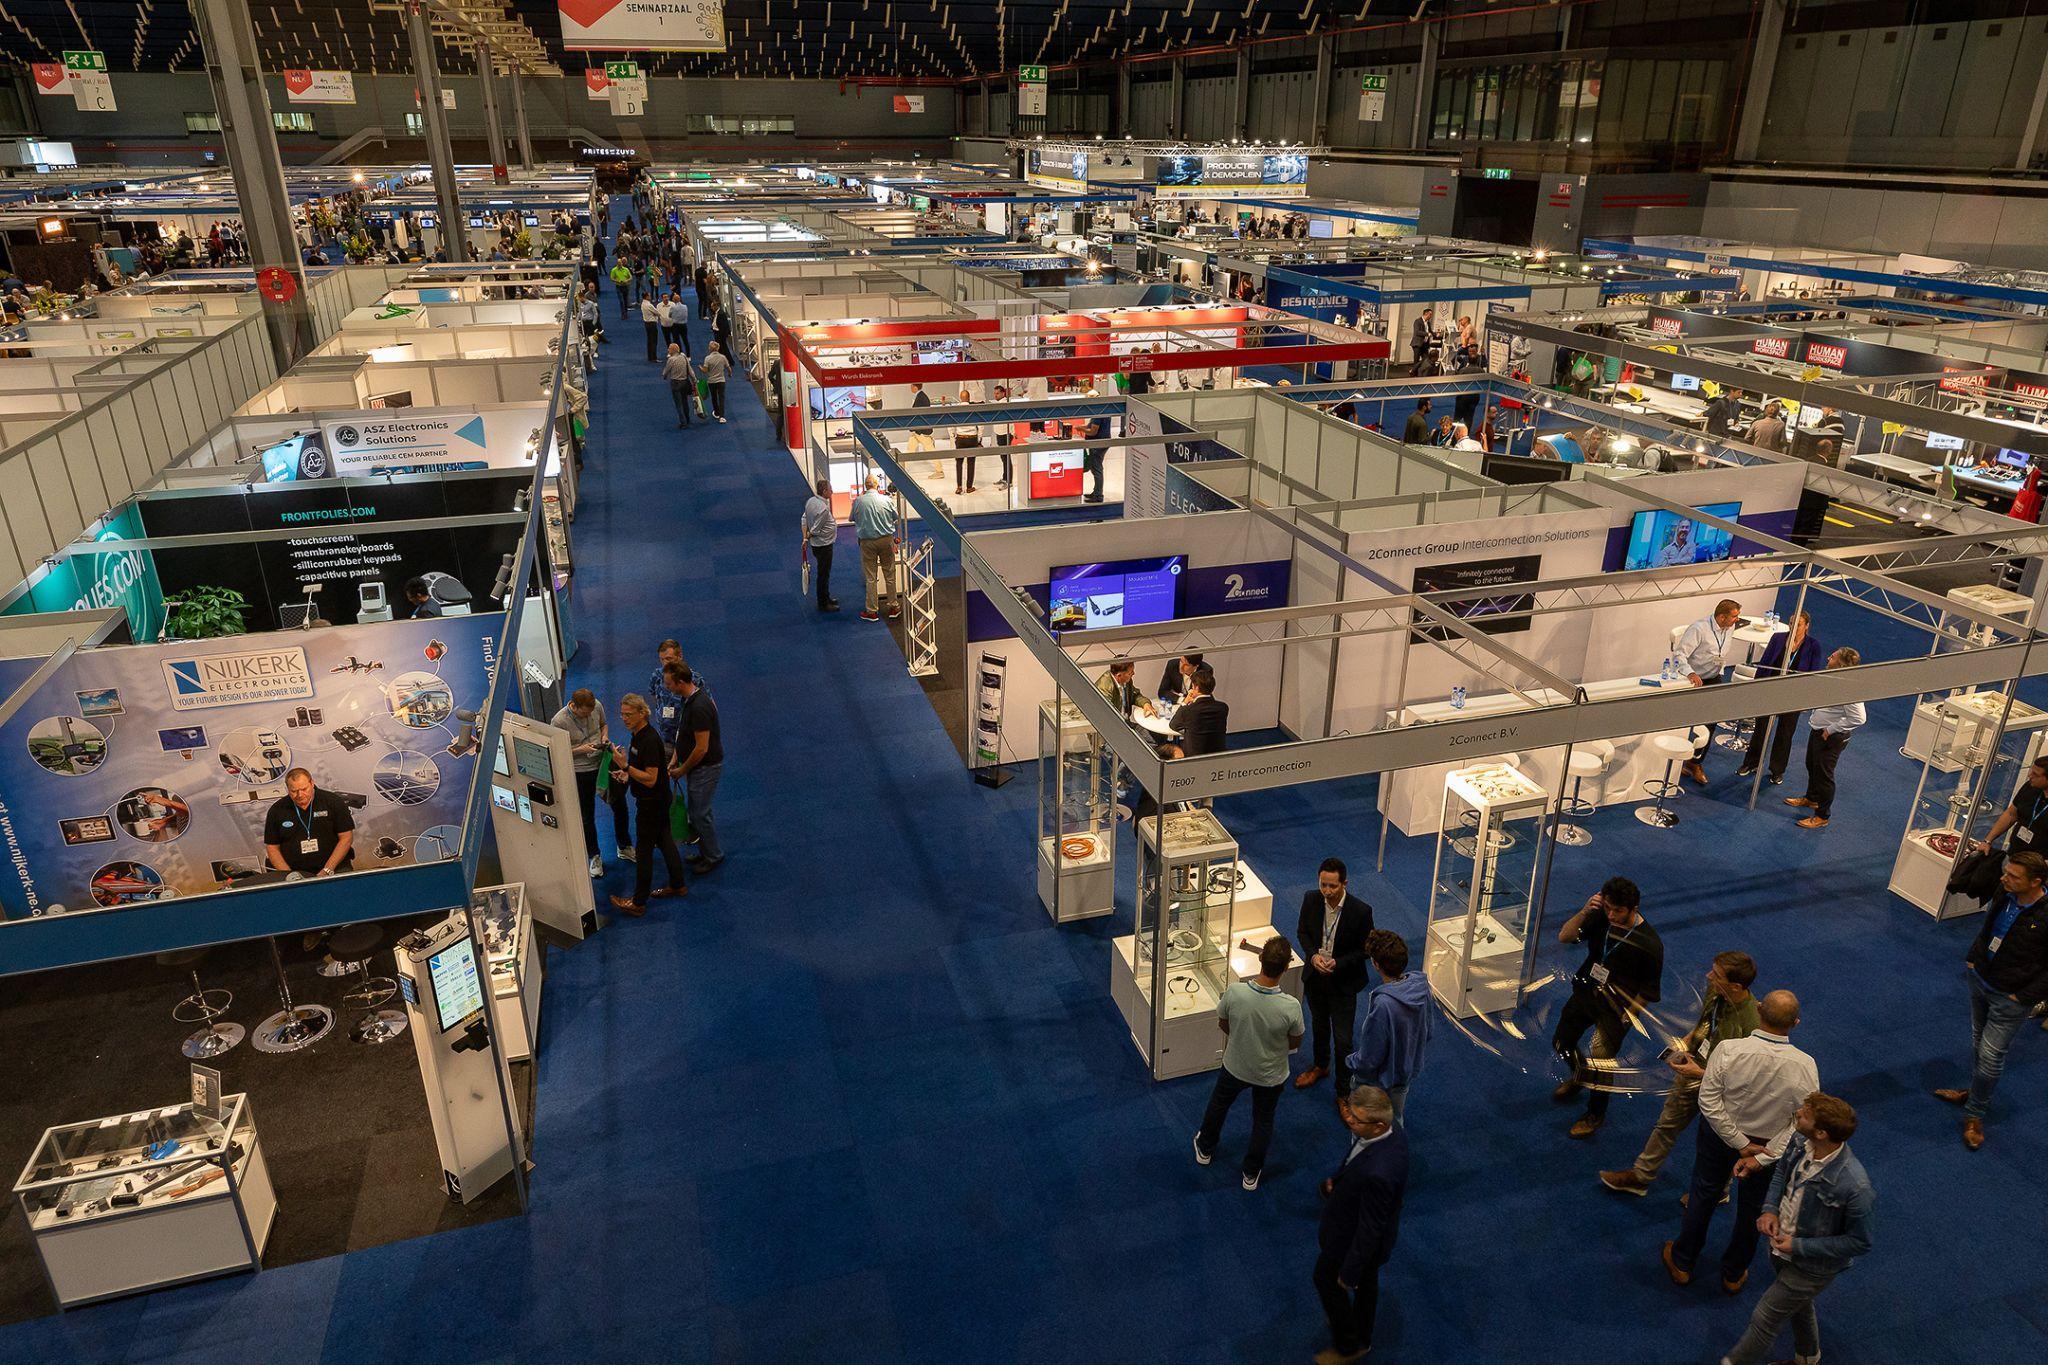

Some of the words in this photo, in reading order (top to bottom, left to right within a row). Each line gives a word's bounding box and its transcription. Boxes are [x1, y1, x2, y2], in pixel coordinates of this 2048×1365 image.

[626, 3, 692, 14] SEMINARZAAL
[658, 16, 664, 26] 1
[96, 97, 106, 109] C
[627, 102, 636, 114] D
[1033, 103, 1040, 114] E
[1371, 110, 1378, 120] F
[1206, 162, 1258, 170] PRODUCTIE-
[1211, 171, 1262, 179] DEMOPLEIN
[1280, 295, 1349, 307] BESTRONICS
[1653, 317, 1681, 329] HUMAN
[1755, 338, 1788, 350] HUMAN
[1808, 343, 1845, 358] HUMAN
[364, 423, 386, 434] ASZ
[388, 420, 449, 433] Electronics
[365, 434, 417, 445] Solutions
[340, 456, 362, 464] YOUR
[362, 453, 397, 462] RELIABLE
[414, 450, 449, 459] PARTNER
[1173, 441, 1190, 461] FOR
[281, 506, 377, 522] FRONTFOLIES.COM
[286, 534, 355, 546] -touchscreens
[1368, 546, 1422, 560] 2Connect
[1424, 542, 1460, 556] Group
[1461, 533, 1542, 551] Interconnection
[1544, 529, 1591, 542] Solutions
[289, 541, 395, 559] -membranekeyboards
[292, 556, 362, 570] -silliconrubber
[363, 553, 403, 568] keypads
[349, 567, 381, 578] panels
[1457, 569, 1484, 578] Infinitely
[1483, 566, 1515, 576] connected
[1474, 577, 1482, 585] to
[1482, 576, 1493, 584] the
[481, 636, 497, 663] Find
[203, 653, 303, 680] NIJKERK
[210, 675, 306, 692] ELECTRONICS
[177, 697, 196, 706] YOUR
[196, 694, 219, 705] FUTURE
[219, 692, 242, 702] DESIGN
[242, 692, 250, 700] IS
[249, 690, 263, 699] OUR
[263, 688, 289, 698] ANSWER
[289, 686, 308, 696] TODAY
[1448, 732, 1497, 746] 2Connect
[1499, 726, 1519, 739] B.V.
[1170, 776, 1196, 788] 7E007
[1210, 770, 1225, 782] 2E
[1227, 760, 1312, 780] Interconnection
